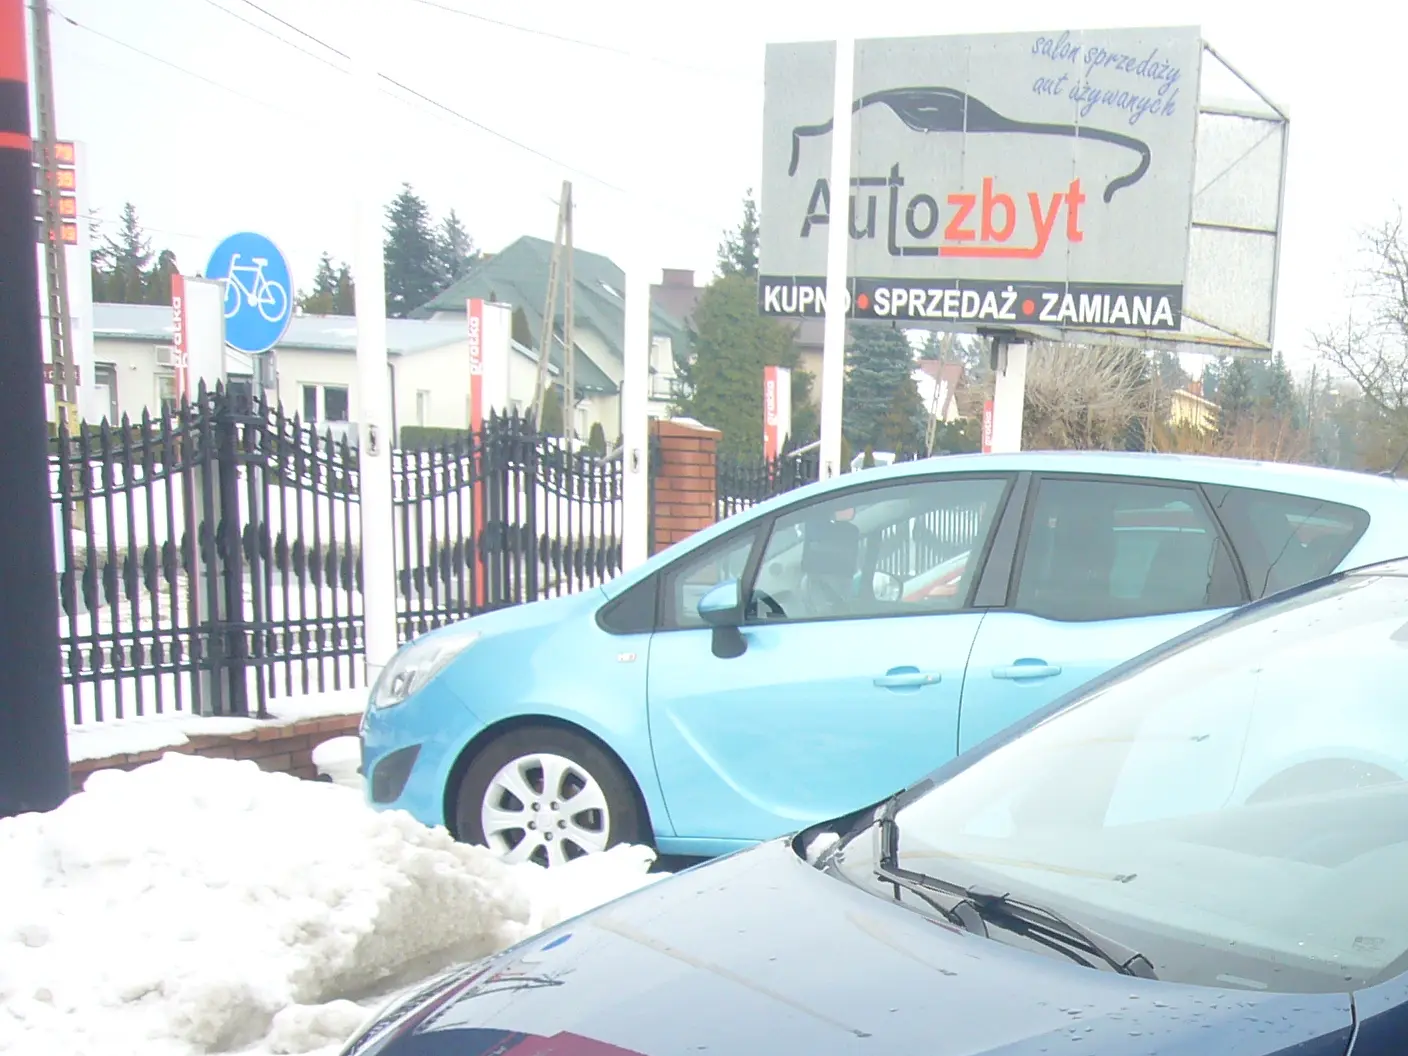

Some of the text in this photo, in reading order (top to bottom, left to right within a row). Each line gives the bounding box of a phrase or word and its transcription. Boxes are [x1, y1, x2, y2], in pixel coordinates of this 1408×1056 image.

[1032, 29, 1181, 97] salon sprzedaży
[1032, 72, 1180, 126] aut używanych
[800, 161, 1086, 260] Autozbyt
[873, 286, 1018, 321] SPRZEDAŻ
[1039, 292, 1175, 327] ZAMIANA
